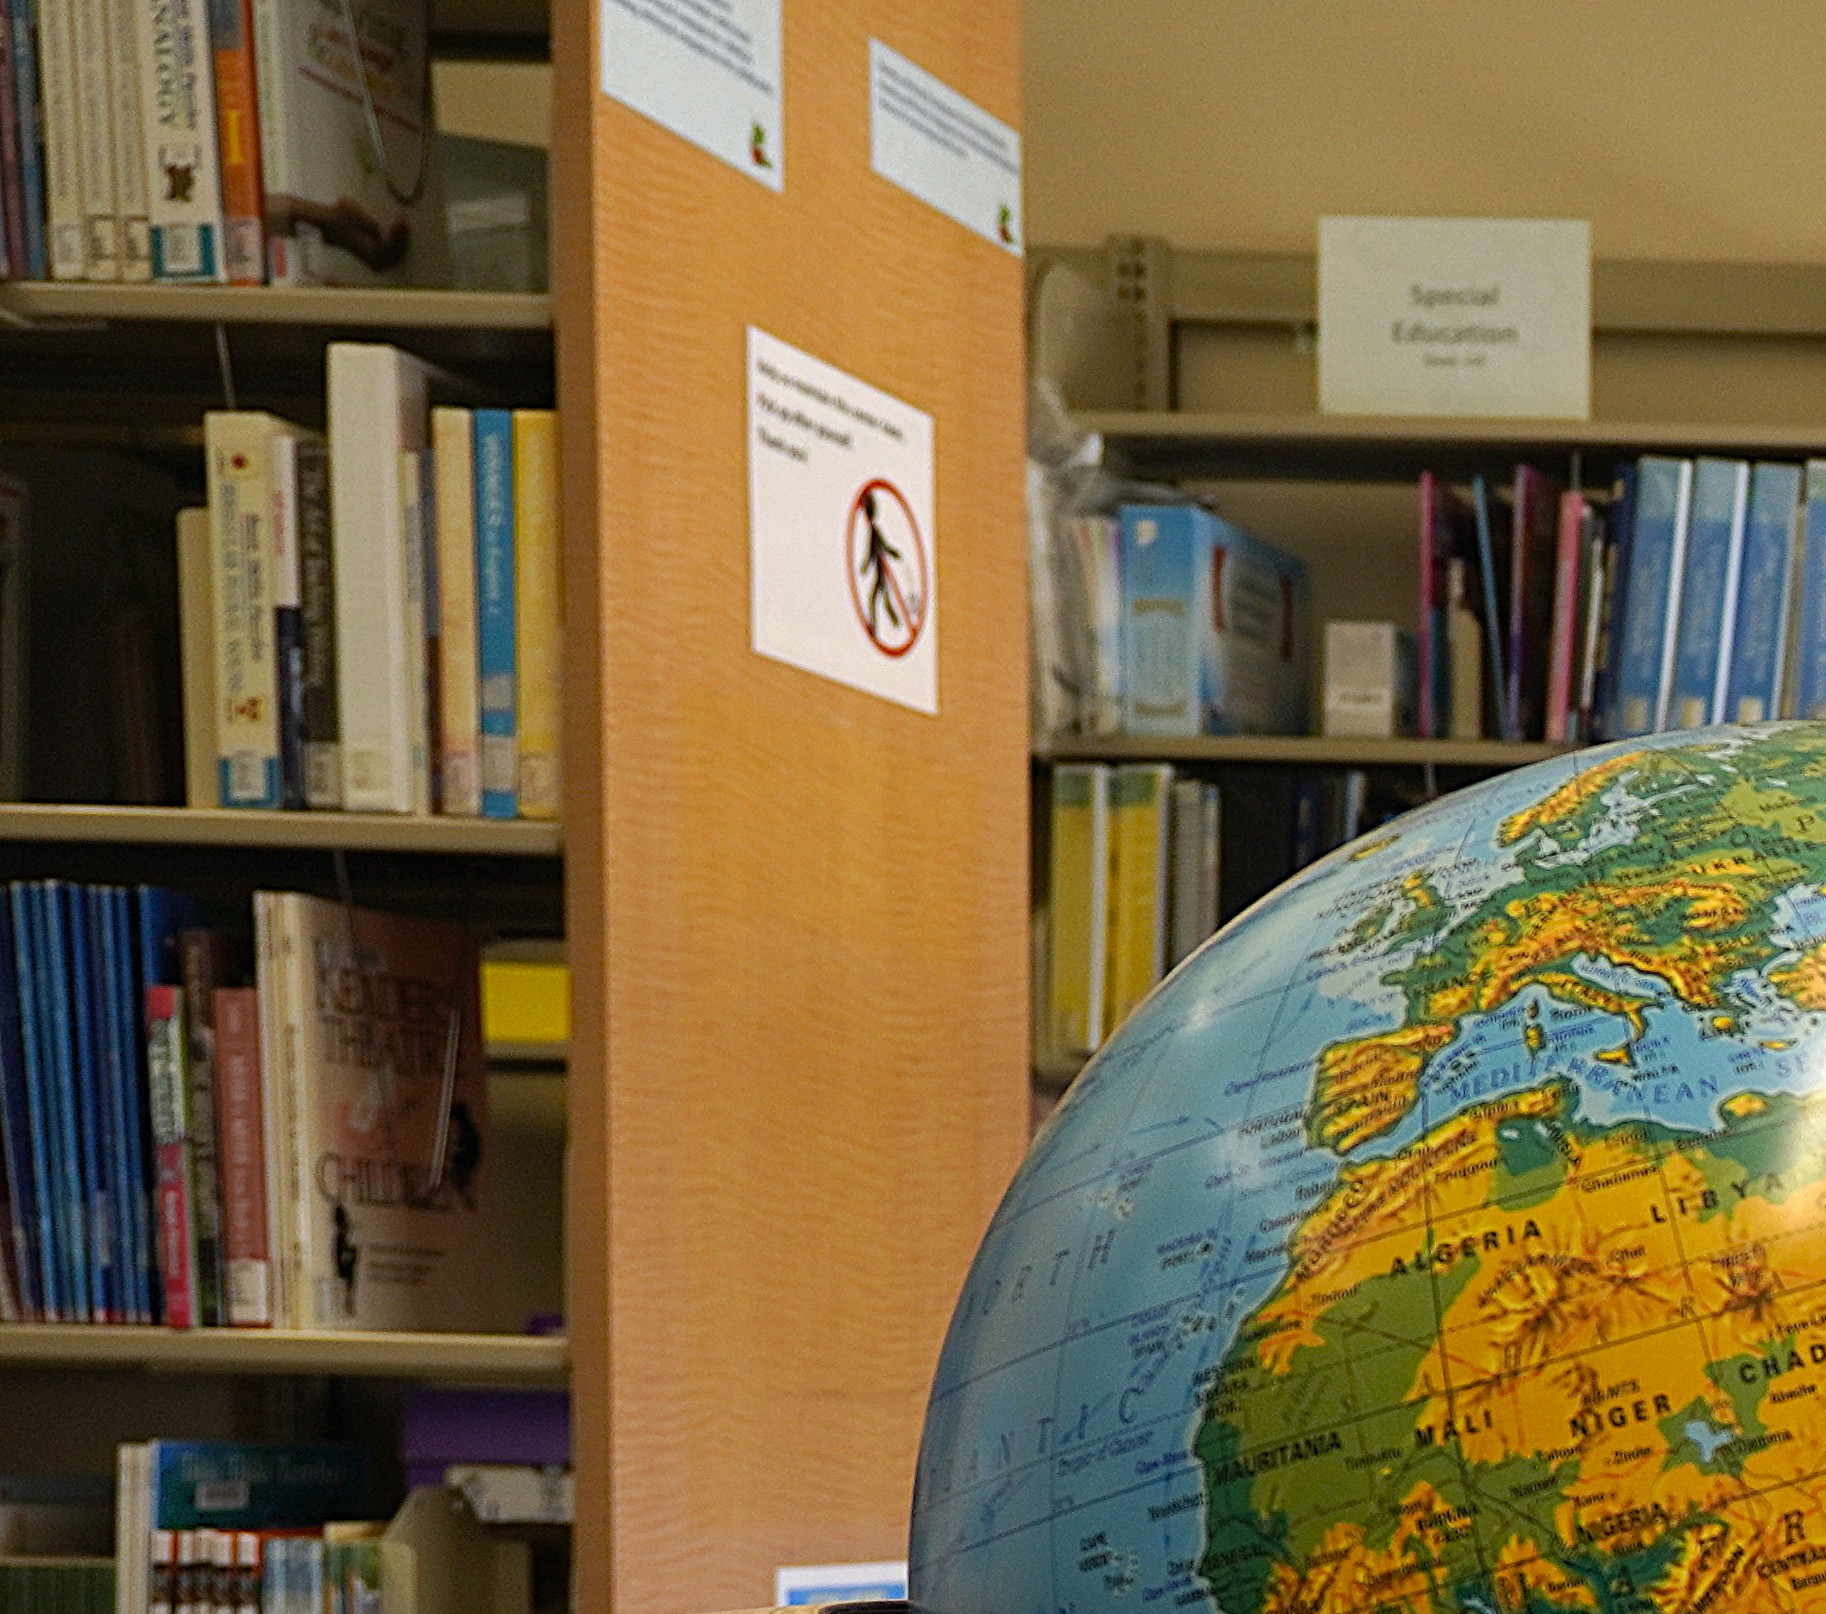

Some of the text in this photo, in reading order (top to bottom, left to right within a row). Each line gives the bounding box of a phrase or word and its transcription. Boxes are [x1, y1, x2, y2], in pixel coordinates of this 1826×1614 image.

[1392, 319, 1519, 347] Education
[1650, 1172, 1784, 1225] LIBYA
[1390, 1219, 1543, 1279] ALGERIA
[1413, 1410, 1494, 1449] MALI
[1568, 1394, 1673, 1438] NIGER
